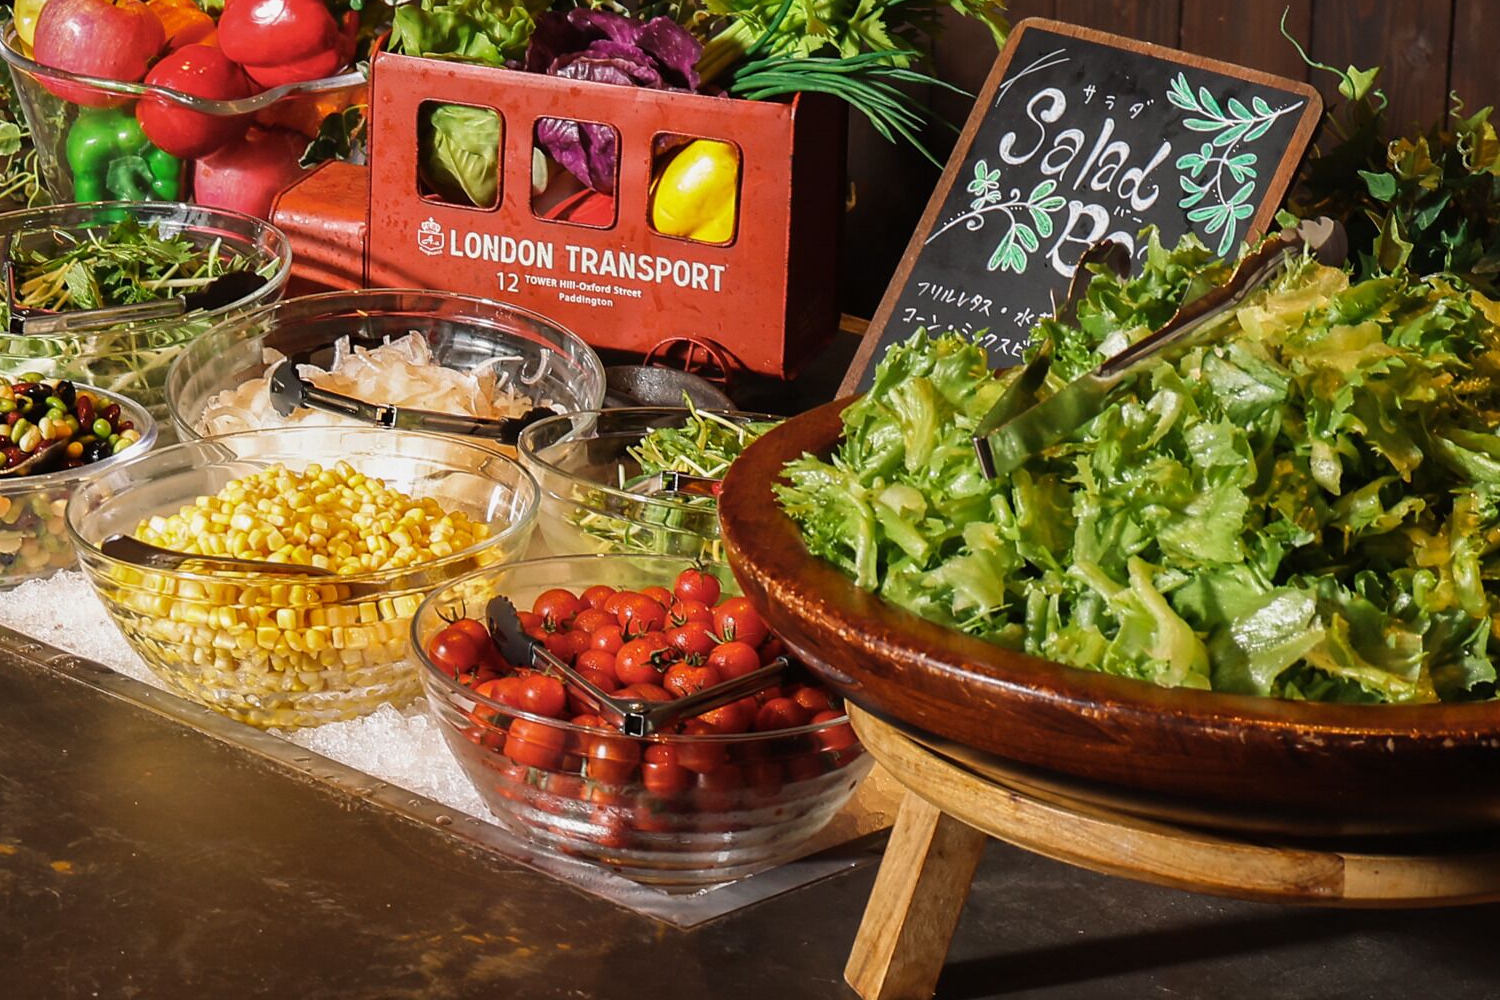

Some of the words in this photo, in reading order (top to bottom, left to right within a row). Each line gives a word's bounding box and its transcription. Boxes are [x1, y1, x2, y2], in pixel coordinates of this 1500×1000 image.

[1082, 83, 1156, 120] サラダ
[998, 86, 1173, 213] Salad
[449, 229, 554, 270] LONDON
[565, 244, 726, 292] TRANSPORT
[495, 271, 519, 293] 12
[524, 274, 557, 288] TOWER
[559, 278, 611, 295] Hill-Oxford
[613, 285, 642, 299] Street
[558, 292, 614, 308] Paddington
